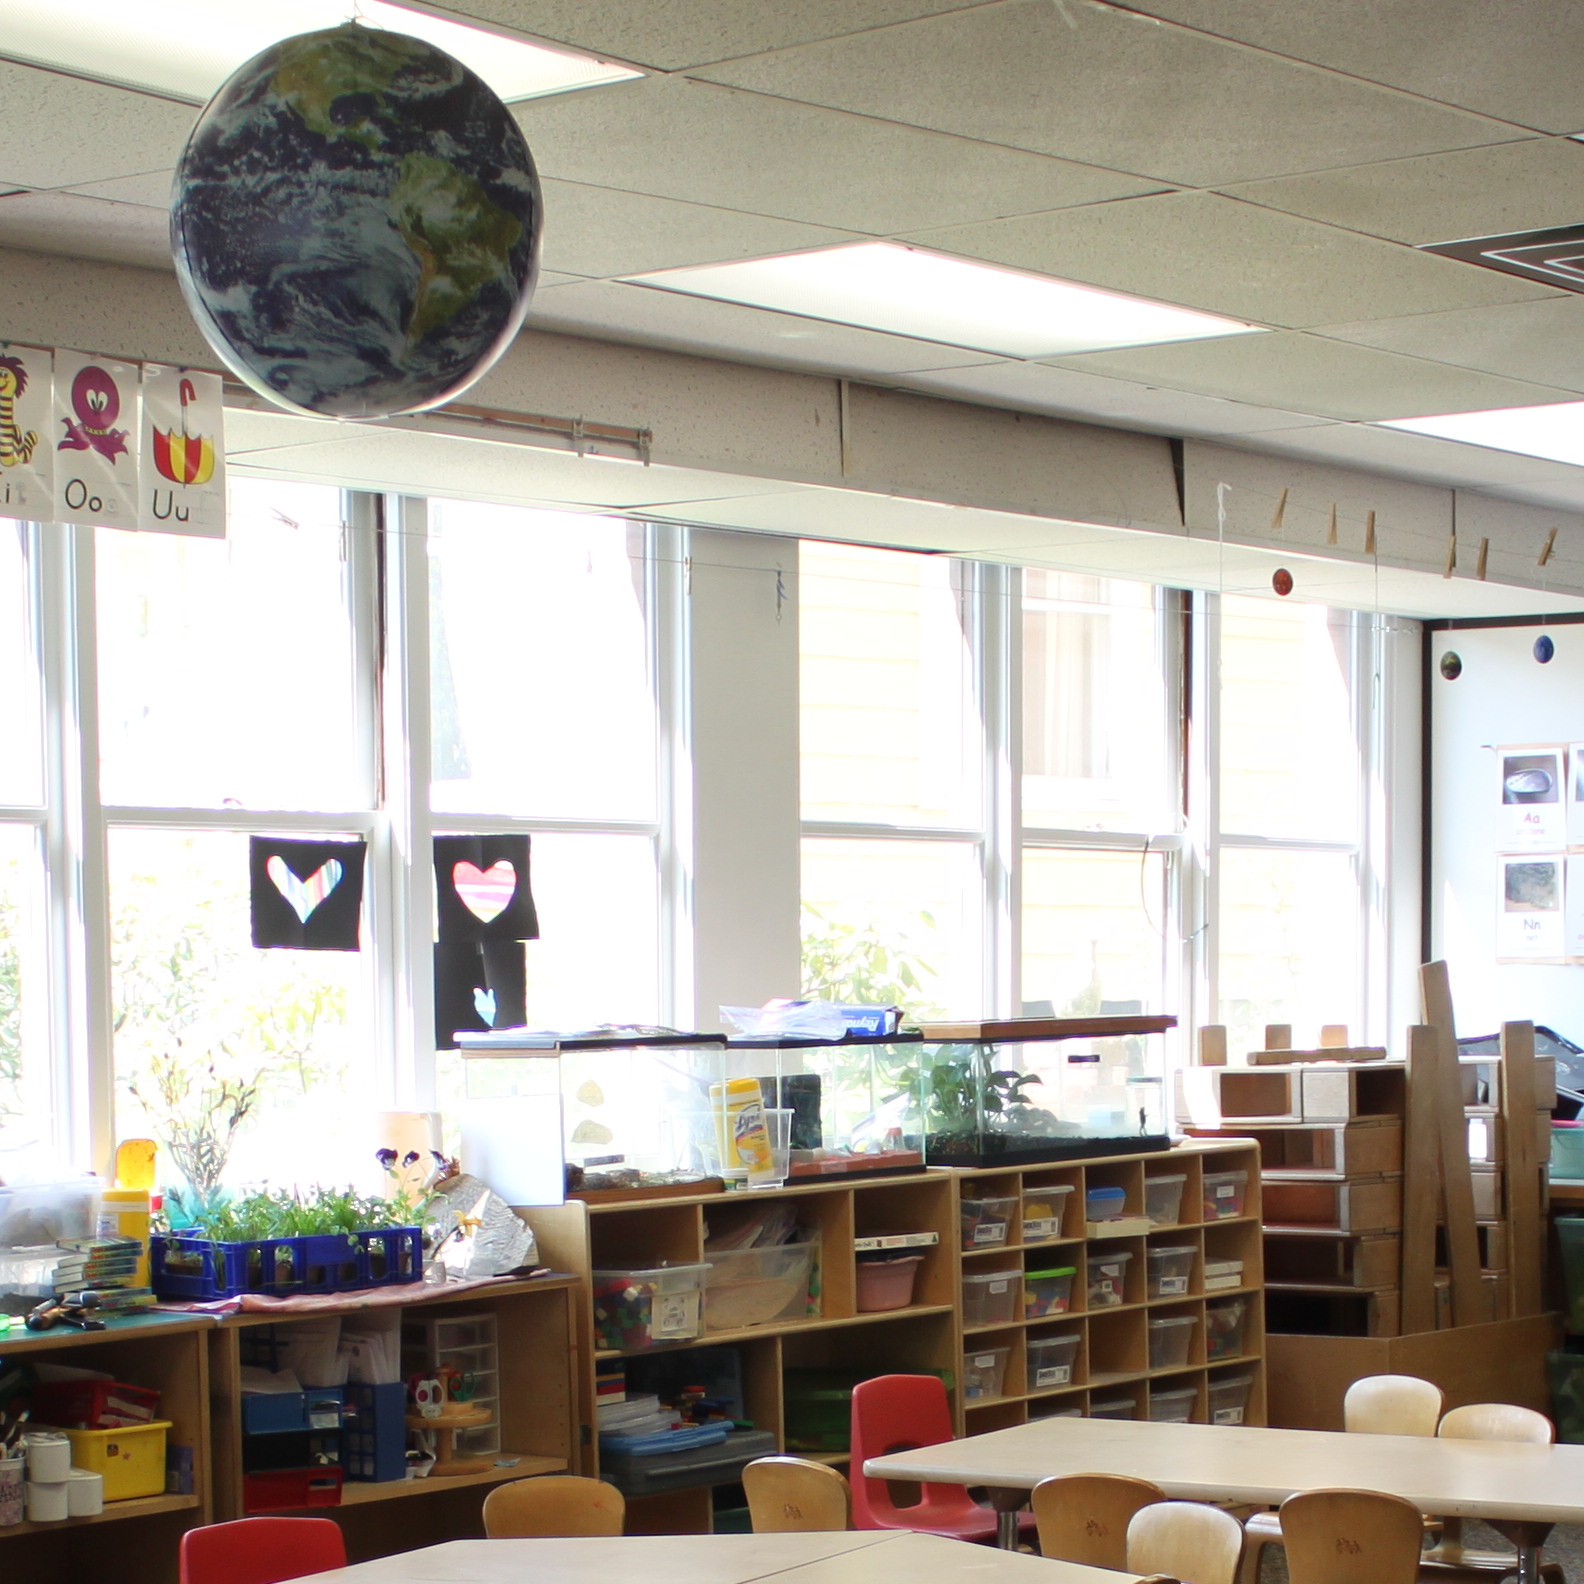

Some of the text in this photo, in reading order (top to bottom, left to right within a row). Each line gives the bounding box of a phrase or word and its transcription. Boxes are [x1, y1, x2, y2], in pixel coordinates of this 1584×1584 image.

[64, 478, 103, 513] Oo
[152, 489, 190, 523] Uu
[1524, 812, 1540, 824] Aa
[1524, 919, 1541, 930] Nn
[846, 1015, 880, 1032] Reyno
